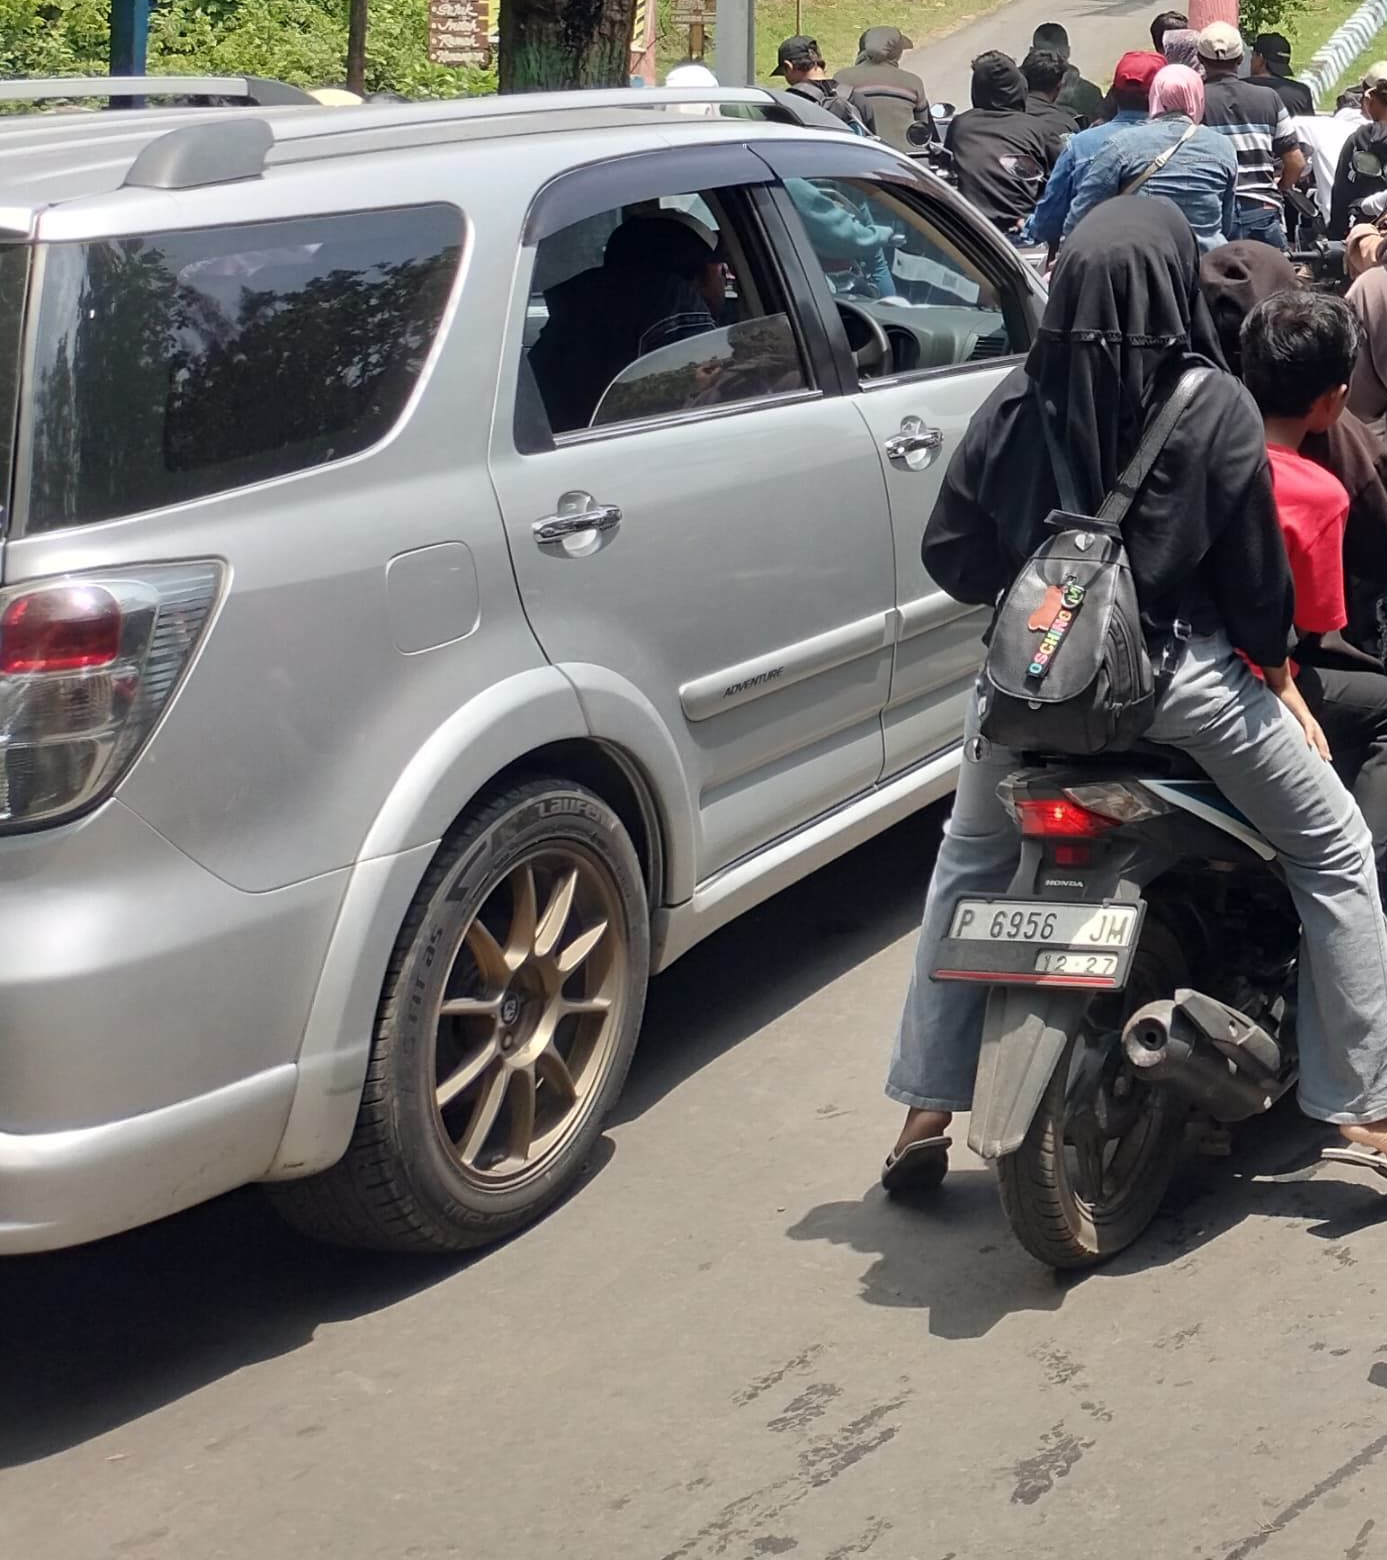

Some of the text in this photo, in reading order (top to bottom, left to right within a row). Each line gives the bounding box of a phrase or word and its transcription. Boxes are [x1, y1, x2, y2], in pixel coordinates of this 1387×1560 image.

[722, 666, 784, 698] ADVENTURE
[1045, 879, 1085, 888] HONDA
[956, 908, 1129, 945] P 6956 JM
